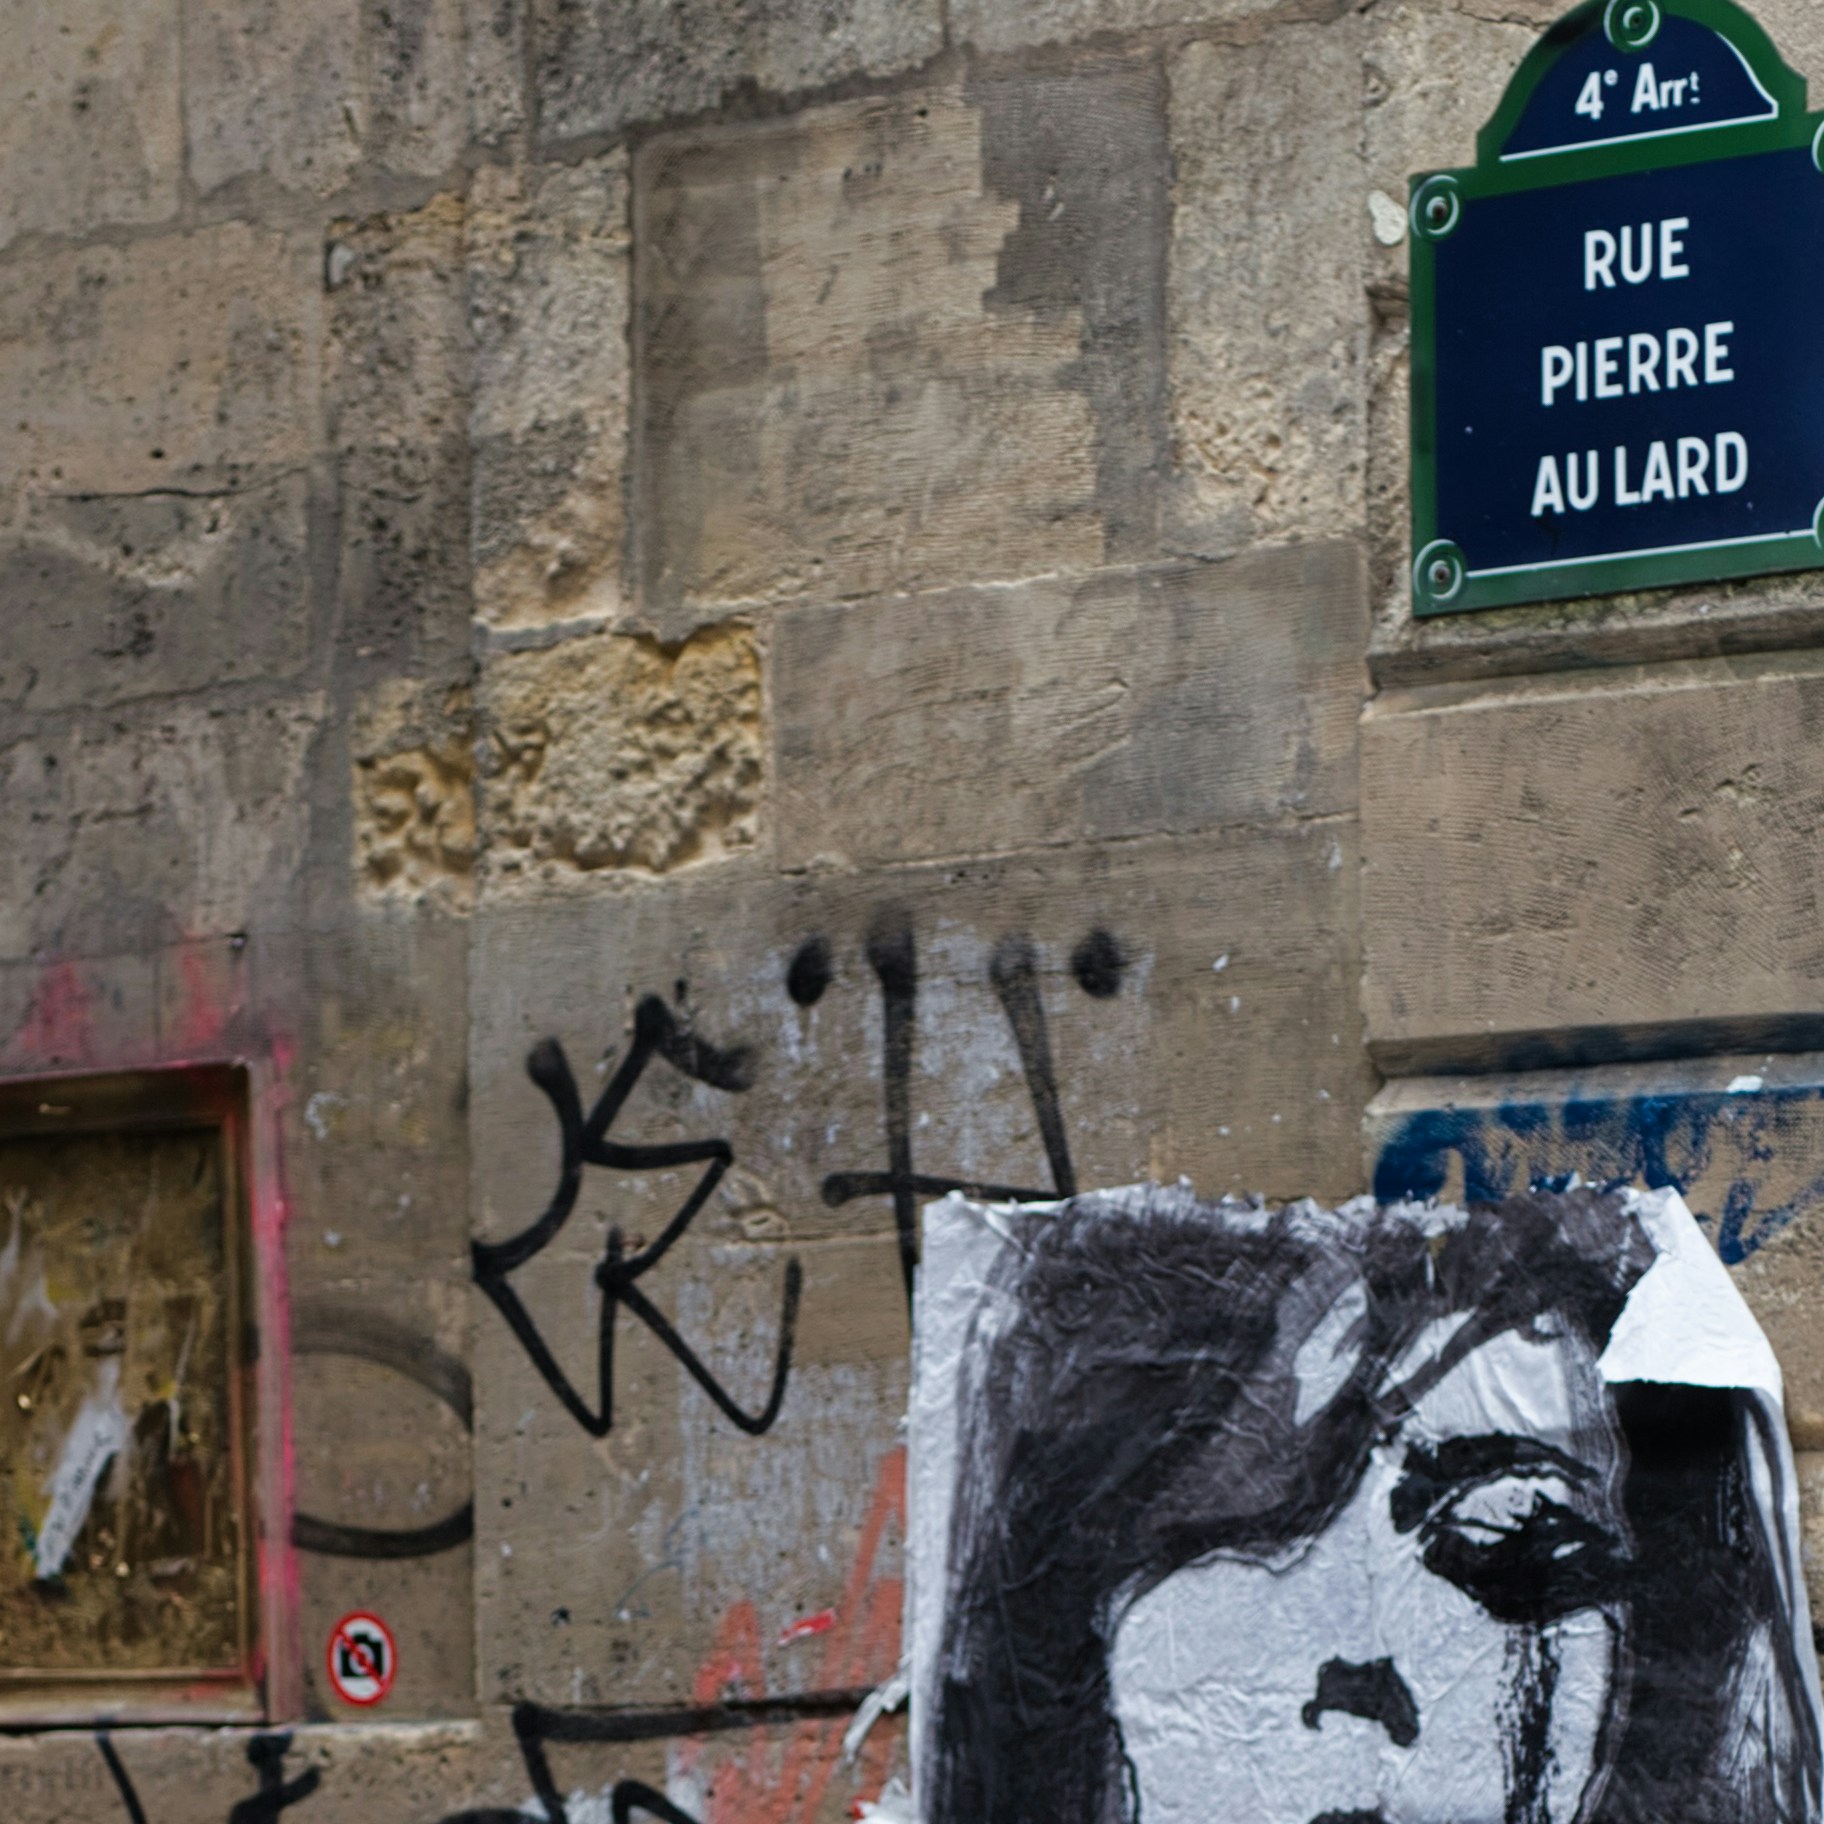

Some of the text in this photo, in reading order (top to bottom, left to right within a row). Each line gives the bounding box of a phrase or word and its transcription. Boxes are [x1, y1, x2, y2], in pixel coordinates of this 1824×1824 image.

[1584, 216, 1689, 291] RUE
[1541, 321, 1735, 406] PIERRE
[1531, 431, 1749, 517] AU LARD
